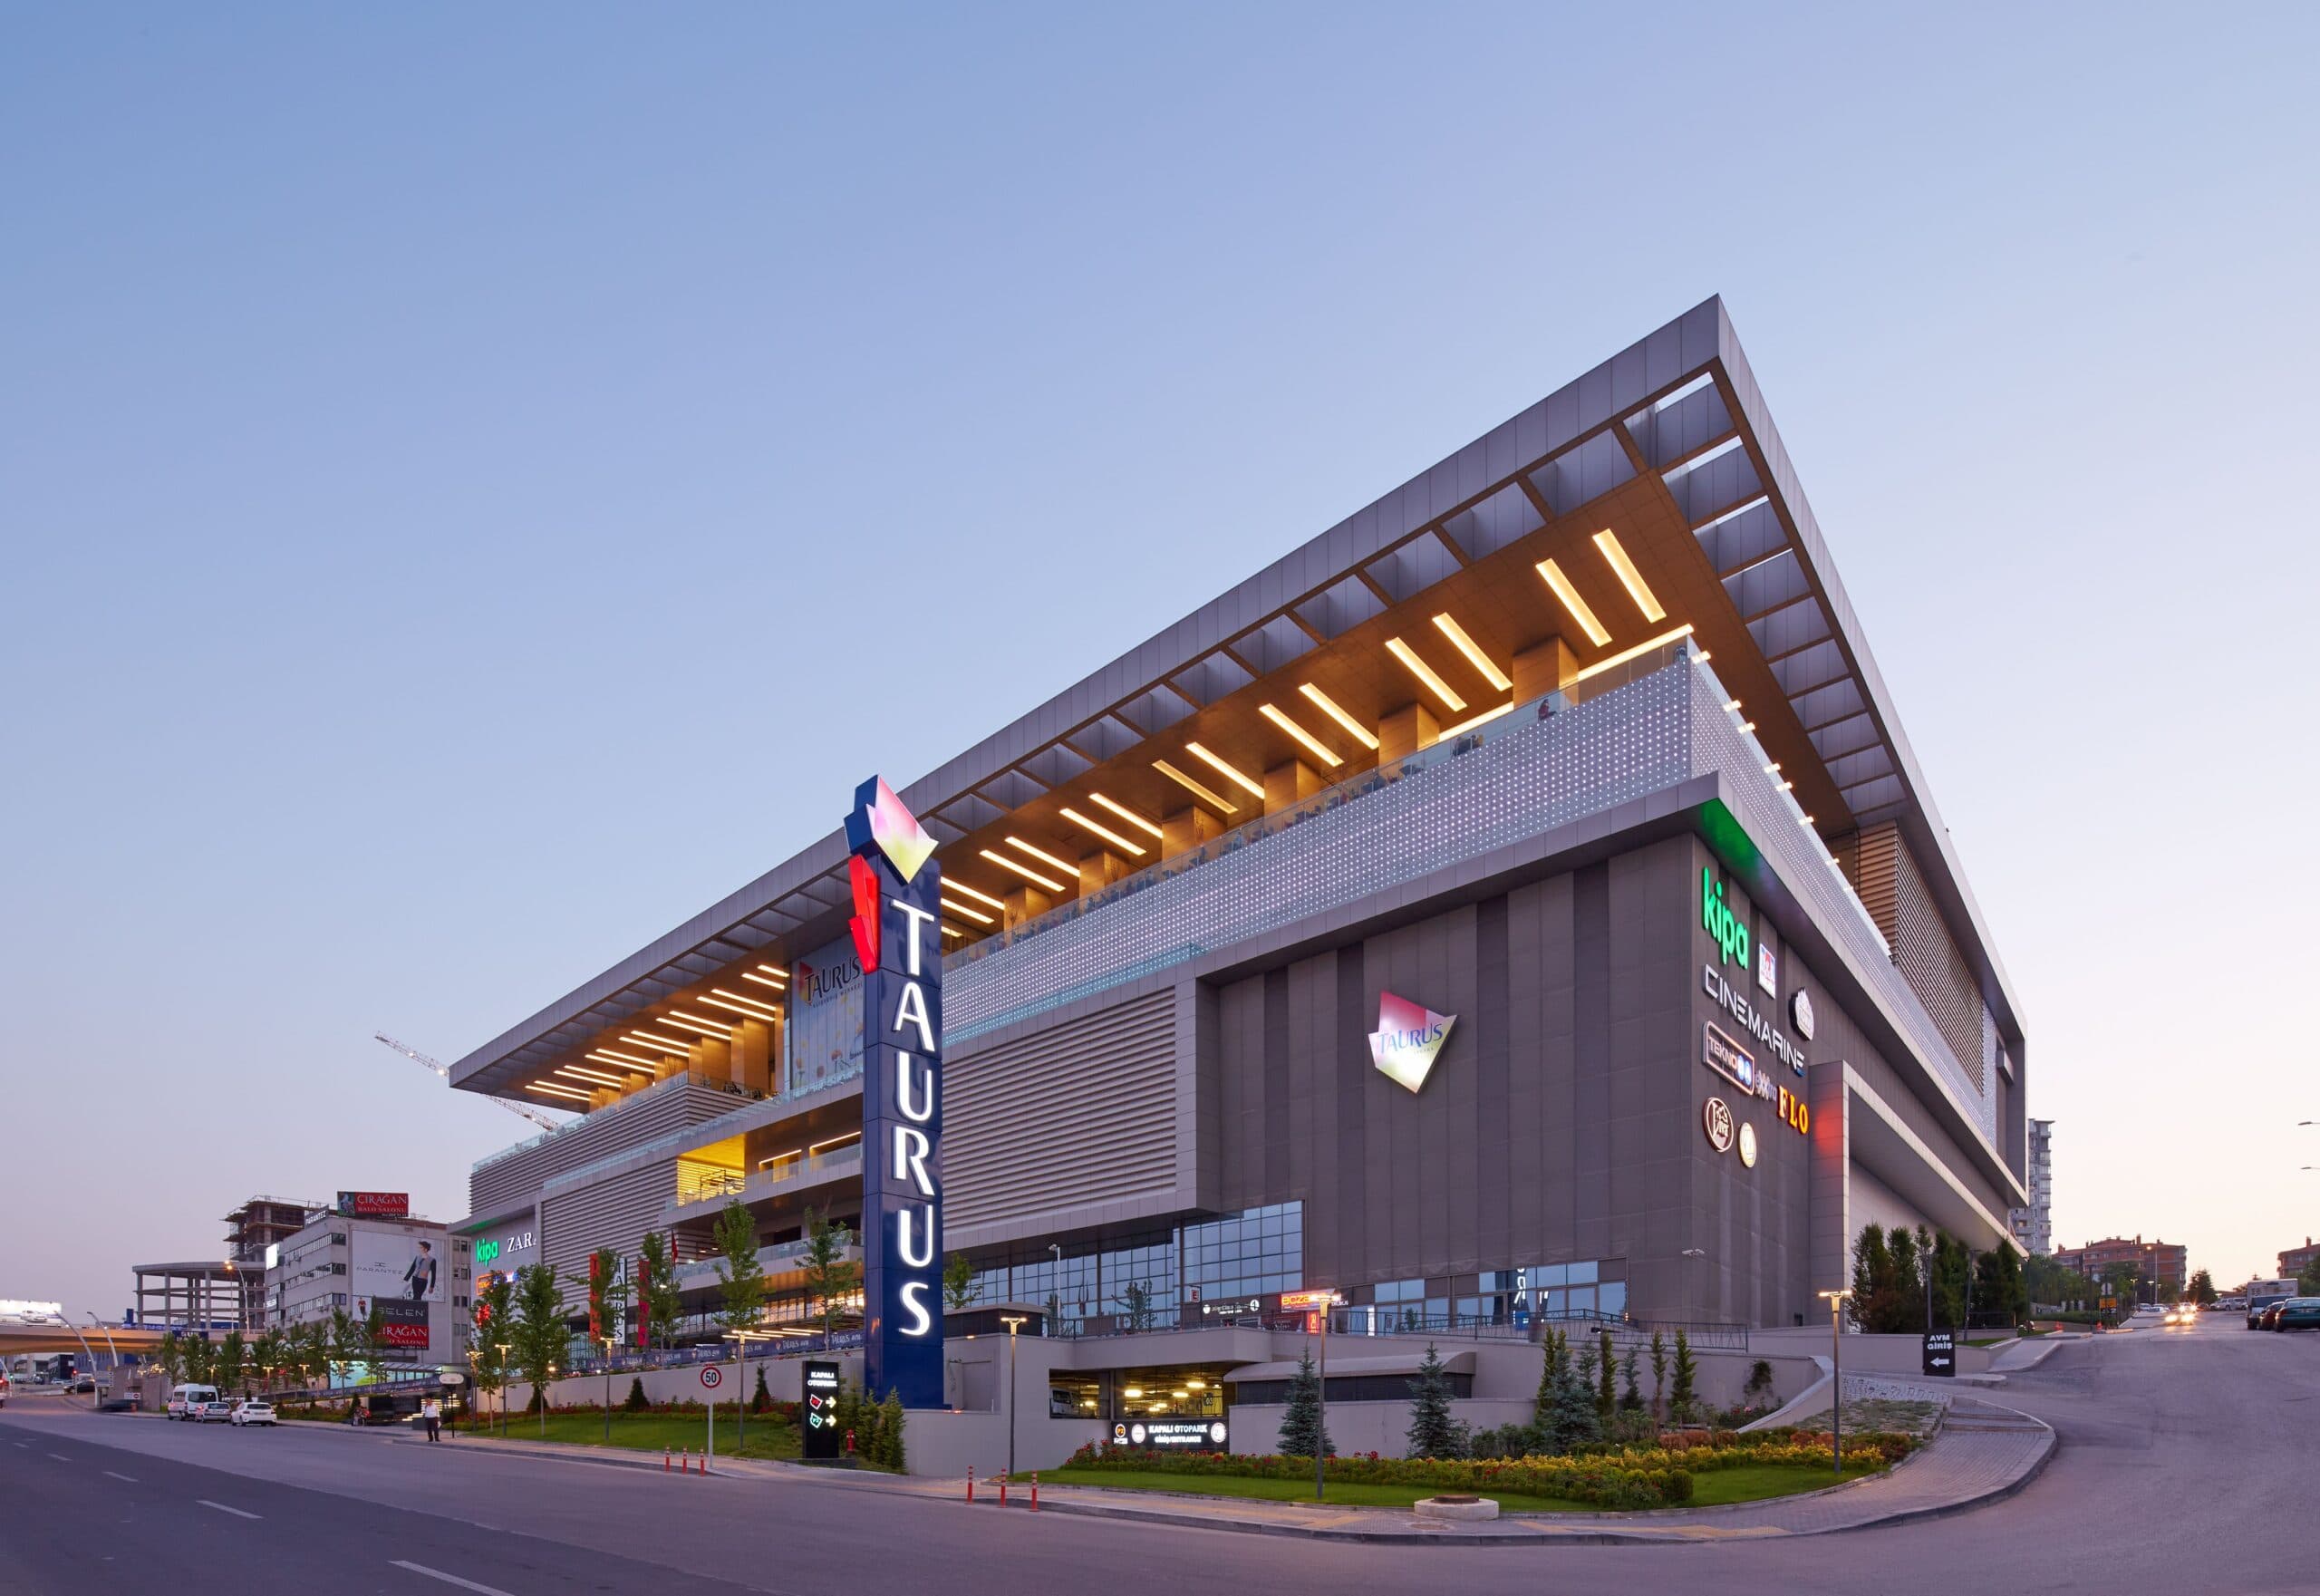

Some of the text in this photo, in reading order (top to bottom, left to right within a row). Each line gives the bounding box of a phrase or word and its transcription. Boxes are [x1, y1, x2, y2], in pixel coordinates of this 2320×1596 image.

[1704, 866, 1749, 971] kipa
[805, 956, 860, 1001] TAURUS
[1378, 1022, 1444, 1054] TAURUS
[1706, 963, 1806, 1078] CINEMARINE
[892, 899, 934, 1336] TAURUS
[1779, 1085, 1809, 1134] FLO
[477, 1238, 499, 1267] kipa
[377, 1326, 428, 1339] IRAĞAN
[705, 1372, 717, 1383] 50
